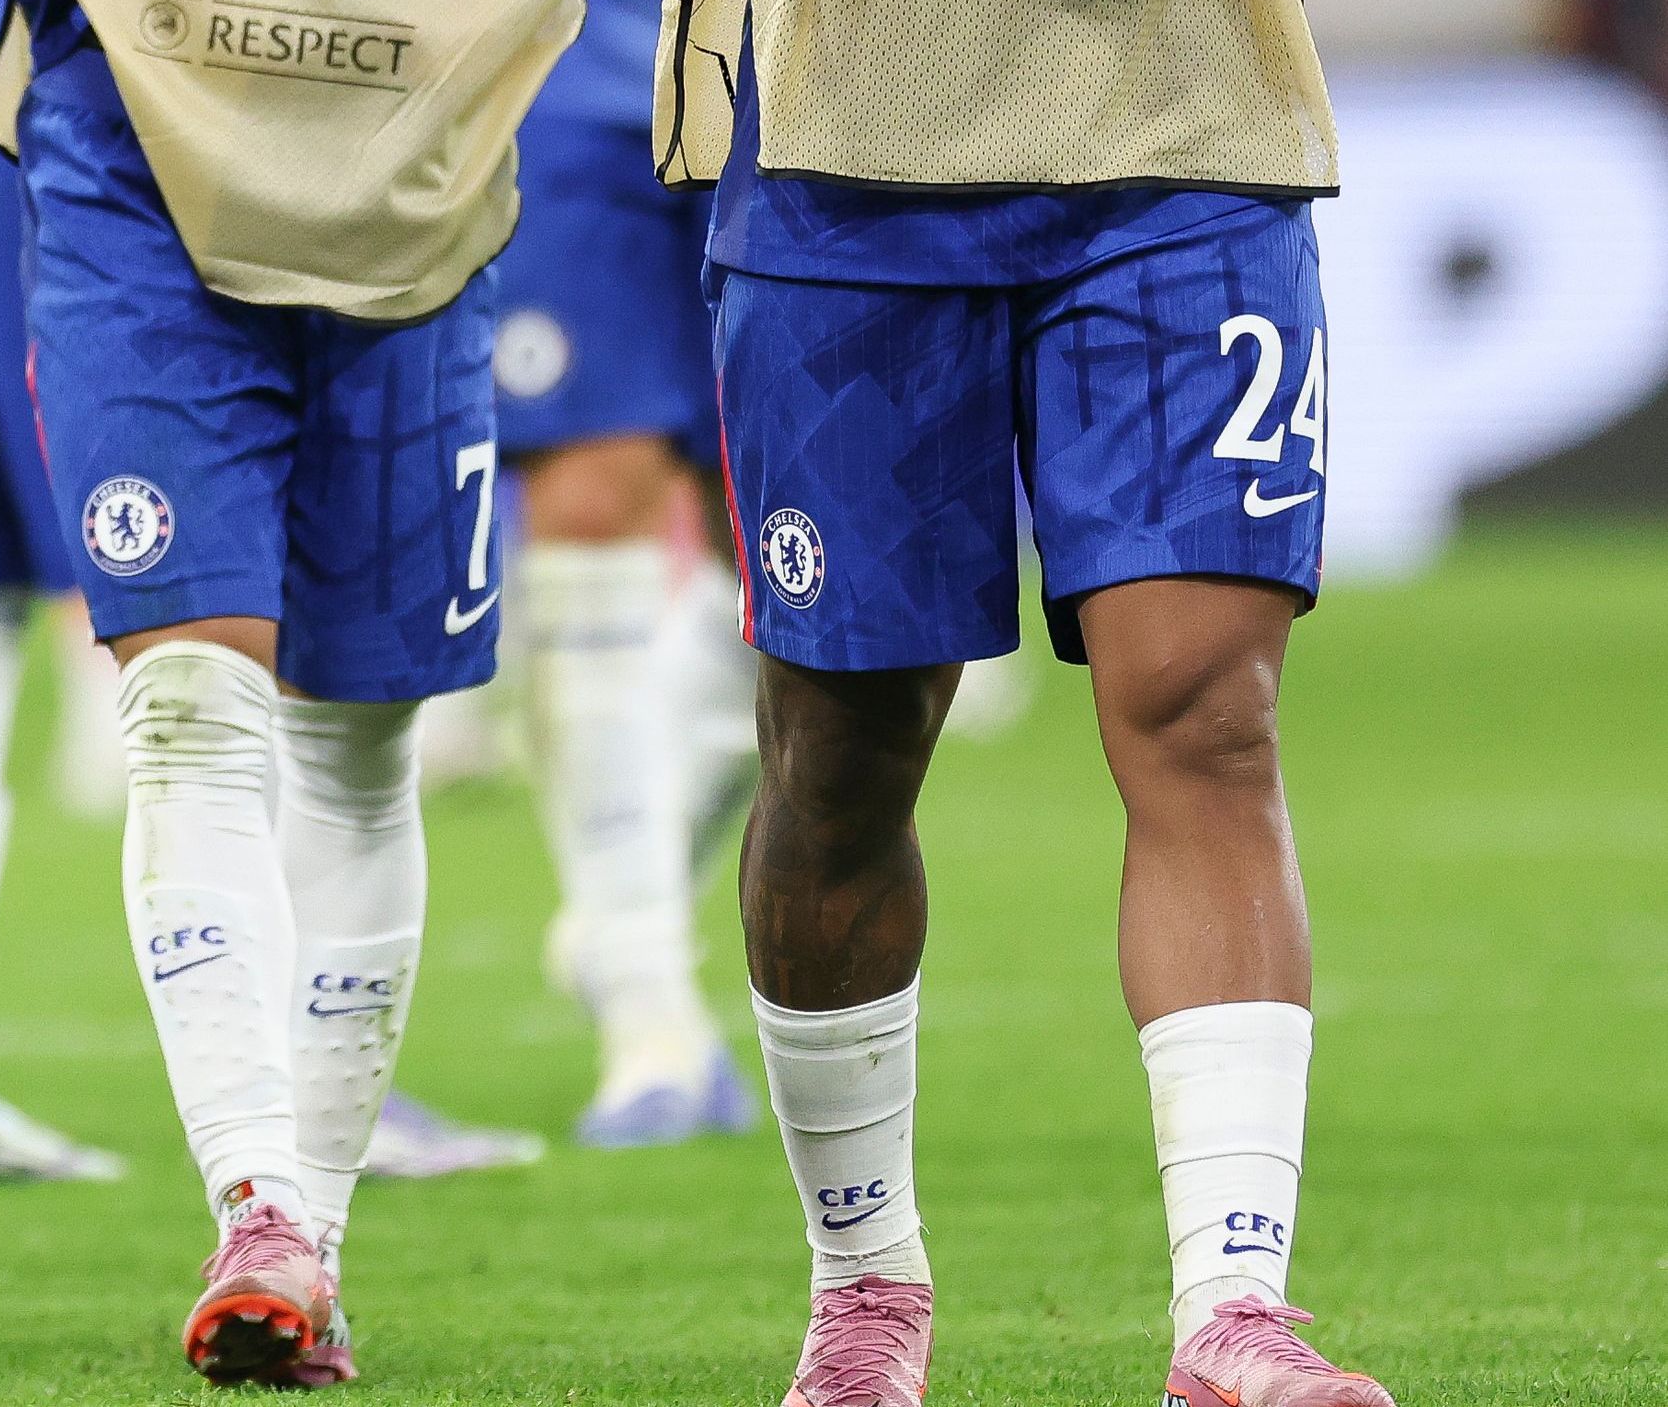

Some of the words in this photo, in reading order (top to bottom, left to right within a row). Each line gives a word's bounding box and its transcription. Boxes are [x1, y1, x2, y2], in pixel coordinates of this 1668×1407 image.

[206, 12, 412, 80] RESPECT
[1213, 315, 1326, 478] 24
[456, 442, 496, 590] 7
[768, 512, 811, 536] CHELSEA
[150, 926, 225, 955] CFC
[817, 1179, 888, 1207] CFC
[1224, 1211, 1284, 1245] CFC
